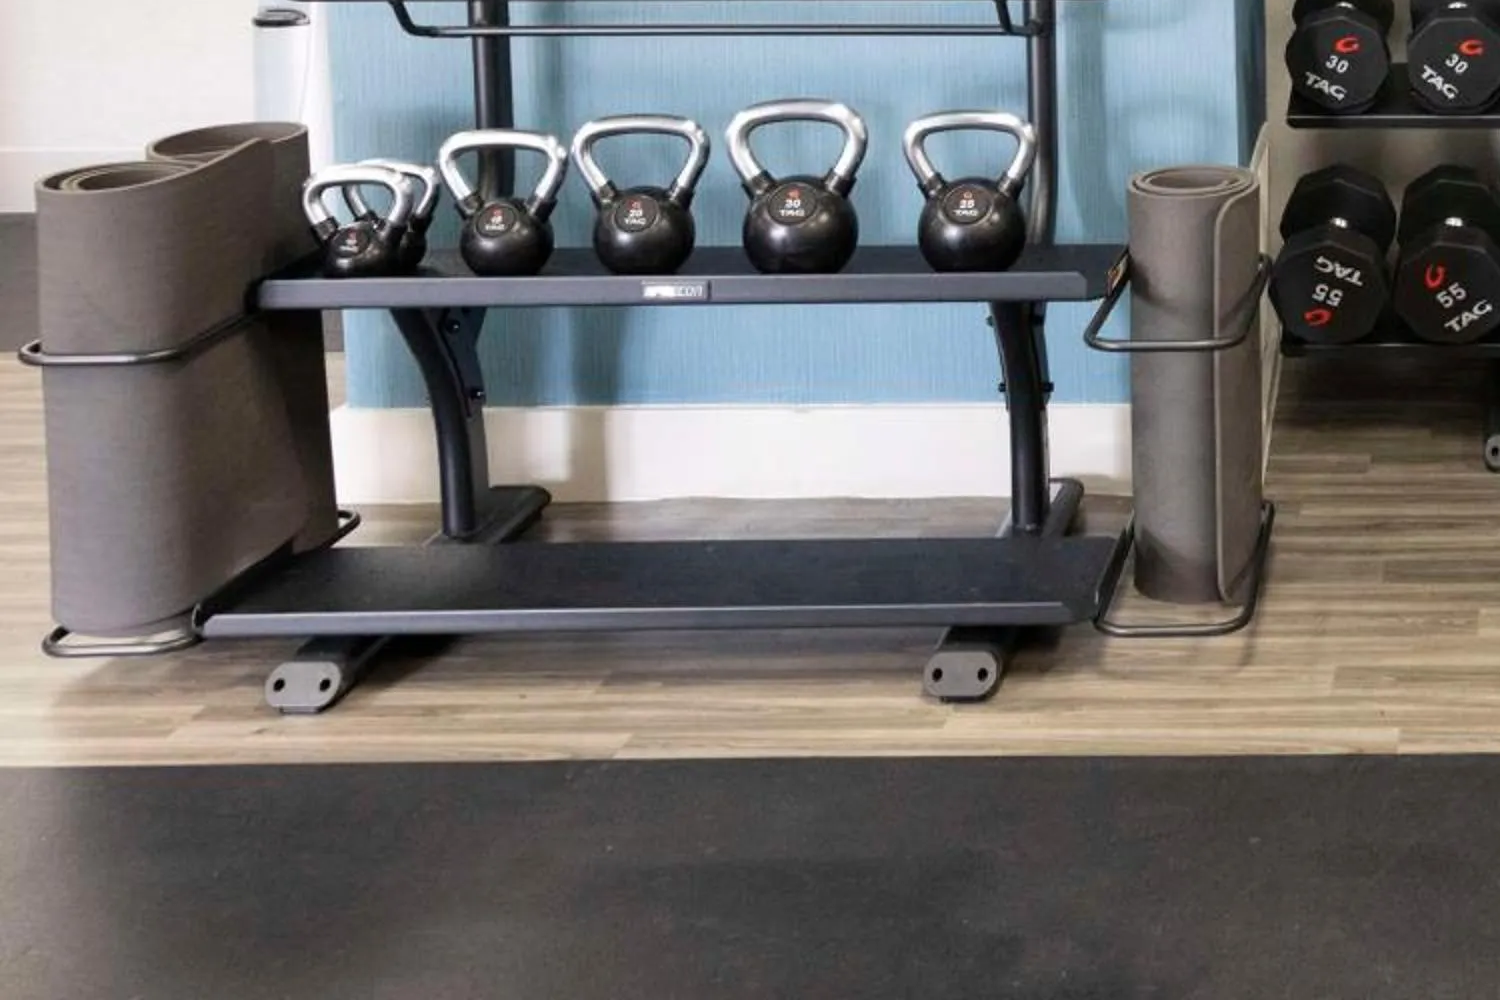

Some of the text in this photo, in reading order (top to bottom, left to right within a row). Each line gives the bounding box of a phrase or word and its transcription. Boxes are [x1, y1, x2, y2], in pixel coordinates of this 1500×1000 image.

[1325, 54, 1349, 74] 30
[1445, 53, 1469, 74] 30
[1305, 71, 1347, 101] TAG
[1420, 64, 1459, 99] TAG
[1313, 255, 1364, 287] TAG
[1311, 283, 1343, 307] 55
[1436, 282, 1467, 308] 55
[1444, 299, 1493, 332] TAG
